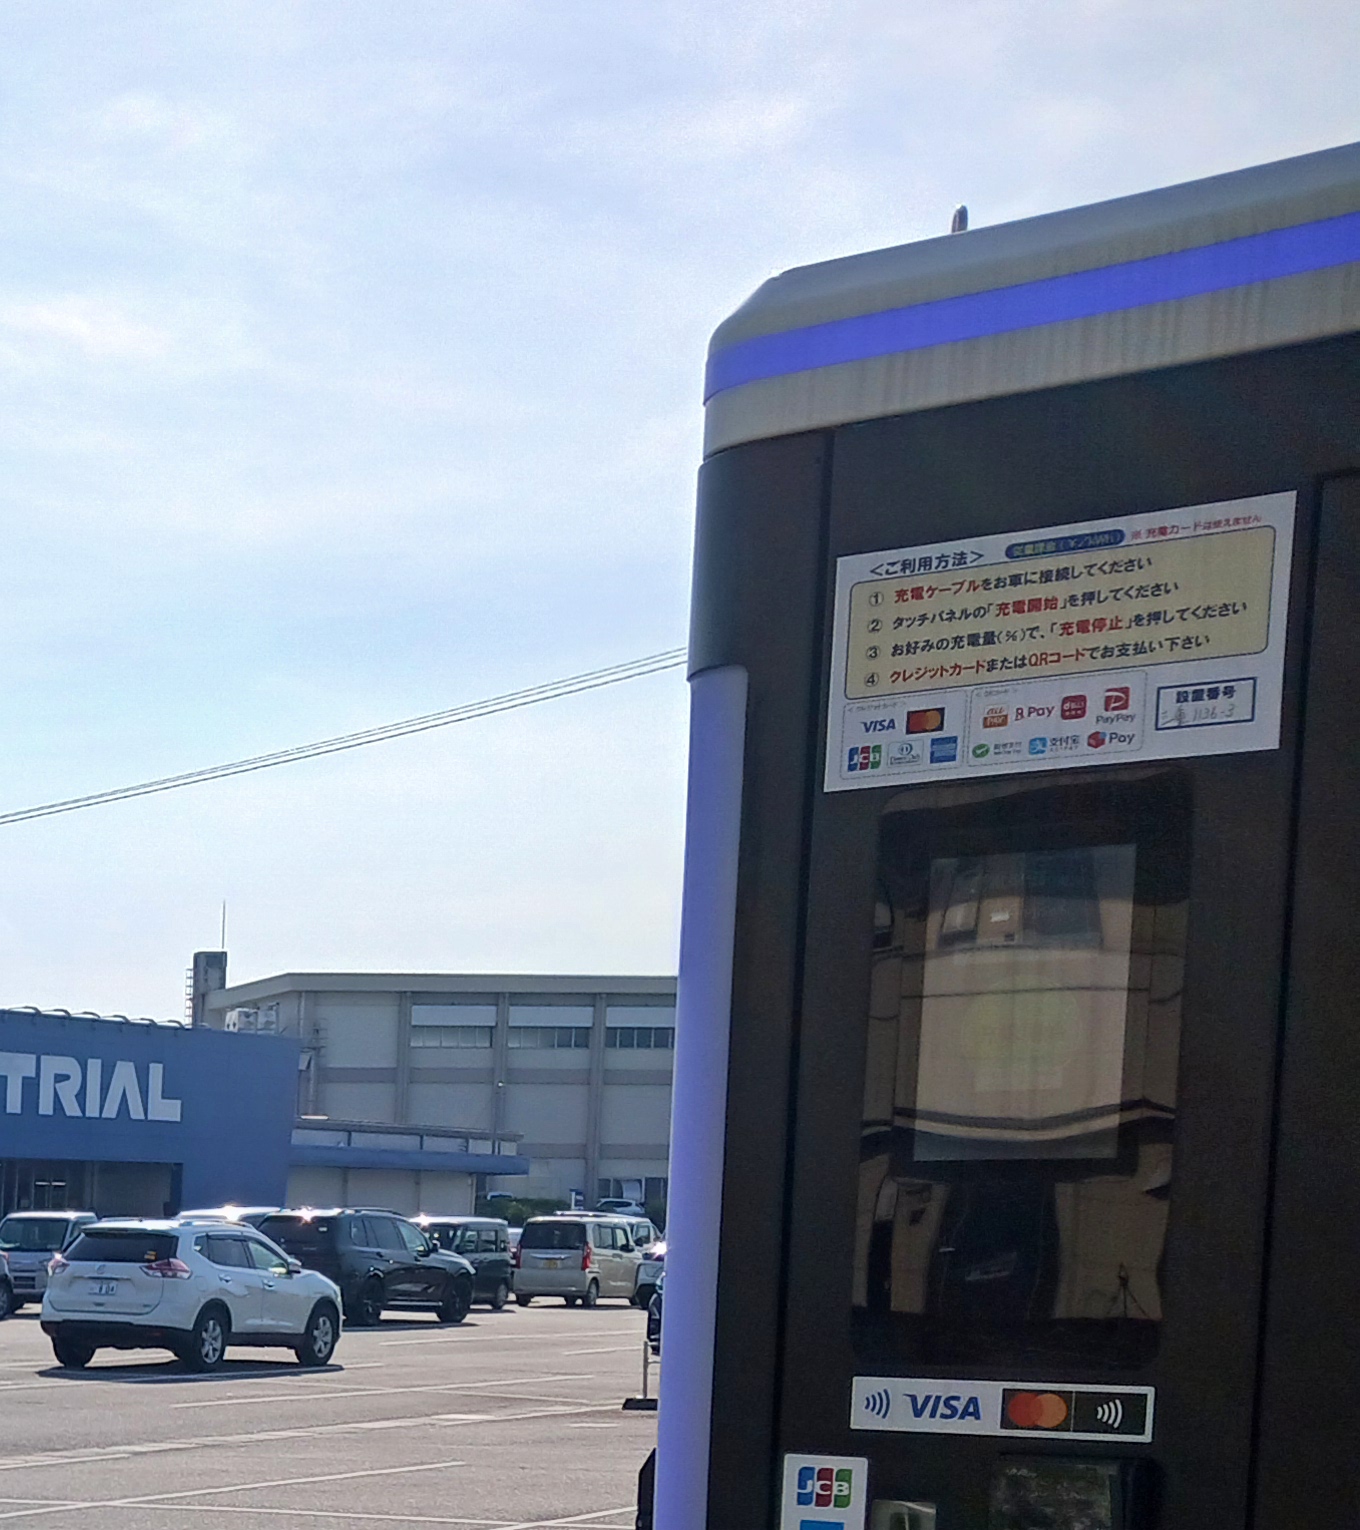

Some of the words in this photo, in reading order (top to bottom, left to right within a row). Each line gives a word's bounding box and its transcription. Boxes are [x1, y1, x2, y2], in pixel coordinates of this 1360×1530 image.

[870, 550, 984, 577] ＜ご利用方法＞
[894, 557, 1153, 604] 充電ケーブルをお車に接続してください
[892, 581, 1179, 630] タッチパネルの「充電開始」を押してください
[889, 635, 1210, 684] クレジットカードまたはQRコードでお支払い下さい
[1028, 706, 1055, 718] Pay
[1095, 713, 1136, 725] PayPay
[861, 719, 896, 733] VISA
[1109, 732, 1136, 745] Pay
[902, 1393, 981, 1420] VISA
